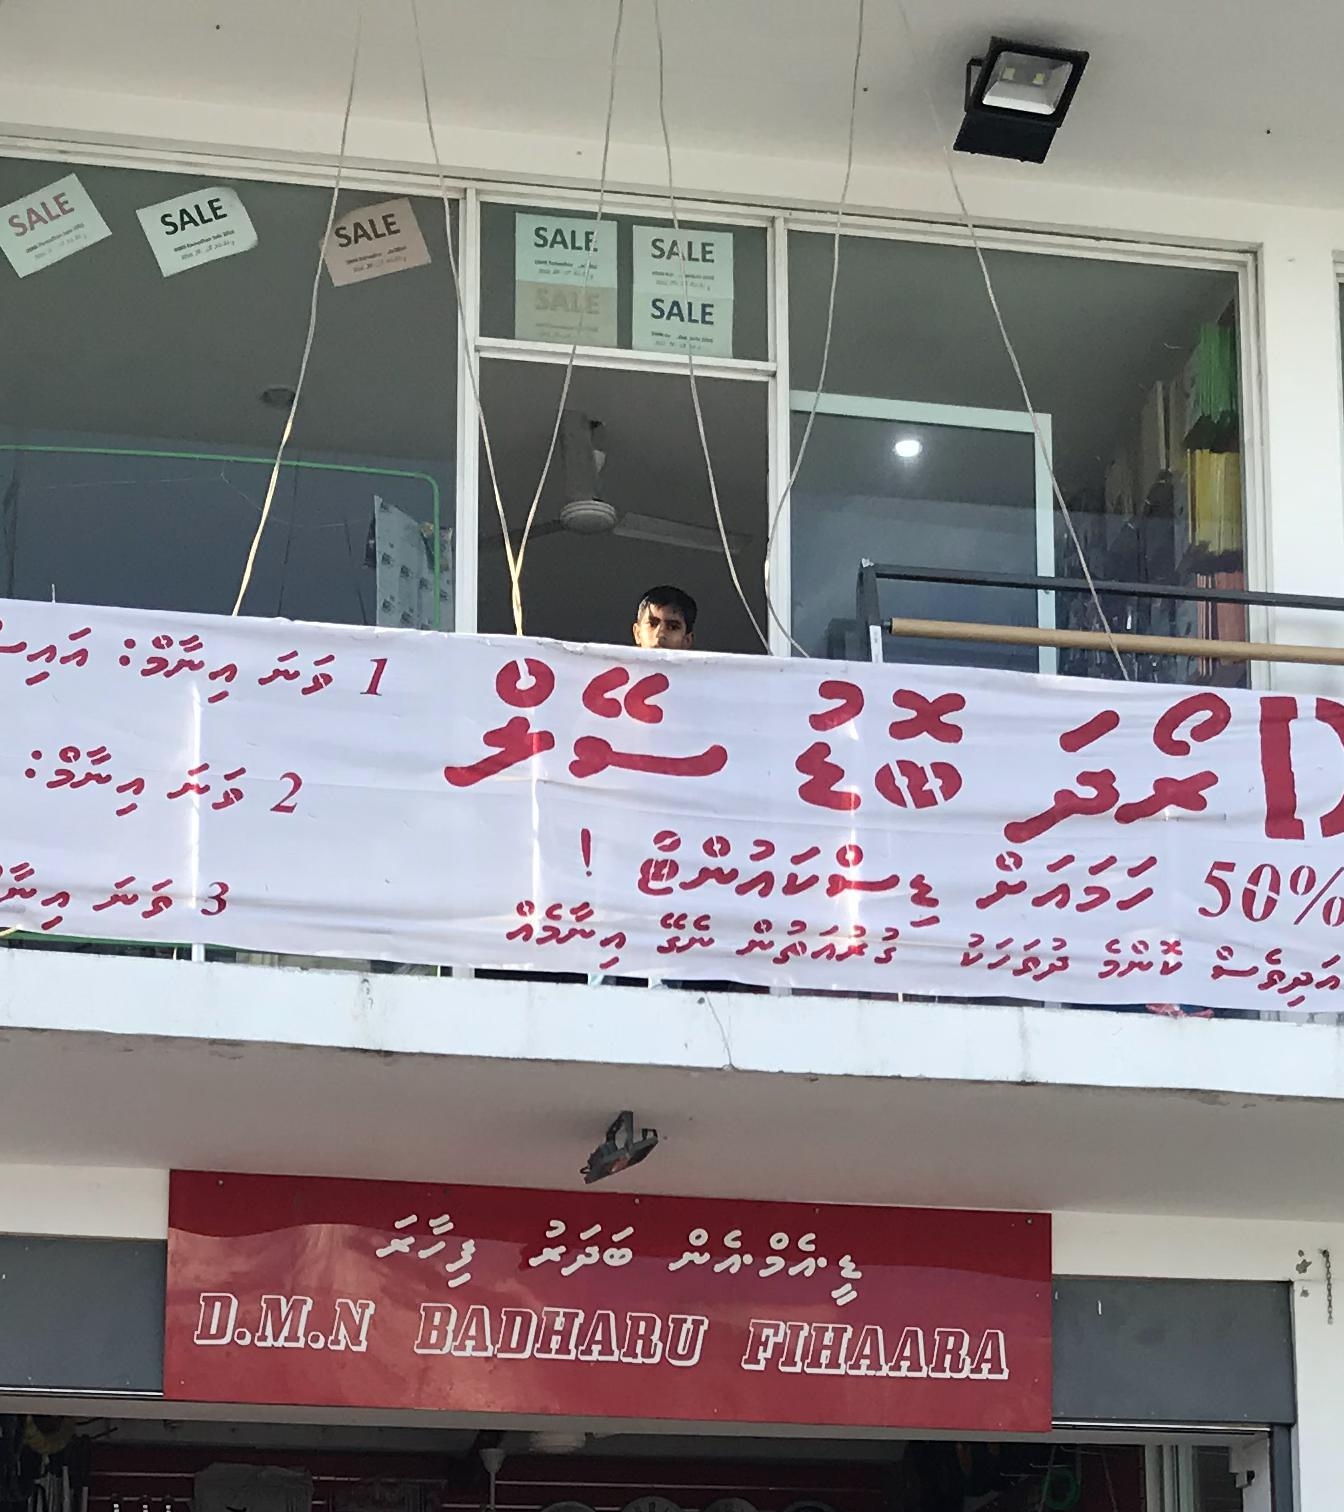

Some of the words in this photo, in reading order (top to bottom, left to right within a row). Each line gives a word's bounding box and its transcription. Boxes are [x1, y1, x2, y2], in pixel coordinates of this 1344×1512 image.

[8, 190, 76, 238] SALE
[160, 196, 228, 236] SALE
[334, 213, 401, 248] SALE
[534, 226, 598, 252] SALE
[651, 238, 715, 263] SALE
[651, 298, 714, 325] SALE
[259, 652, 334, 694] ވަނަ
[368, 659, 386, 694] 1
[444, 659, 727, 786] ސޭލް
[796, 681, 965, 810] ބޮޑު
[168, 764, 244, 809] ވަނަ
[1004, 693, 1231, 843] ރޯދަ
[273, 773, 301, 812] 2
[95, 877, 172, 918] ވަނަ
[200, 880, 231, 916] 3
[194, 1292, 372, 1352] D.M.N
[413, 1302, 709, 1368] BADHARU
[741, 1320, 1011, 1381] FIHAARA
